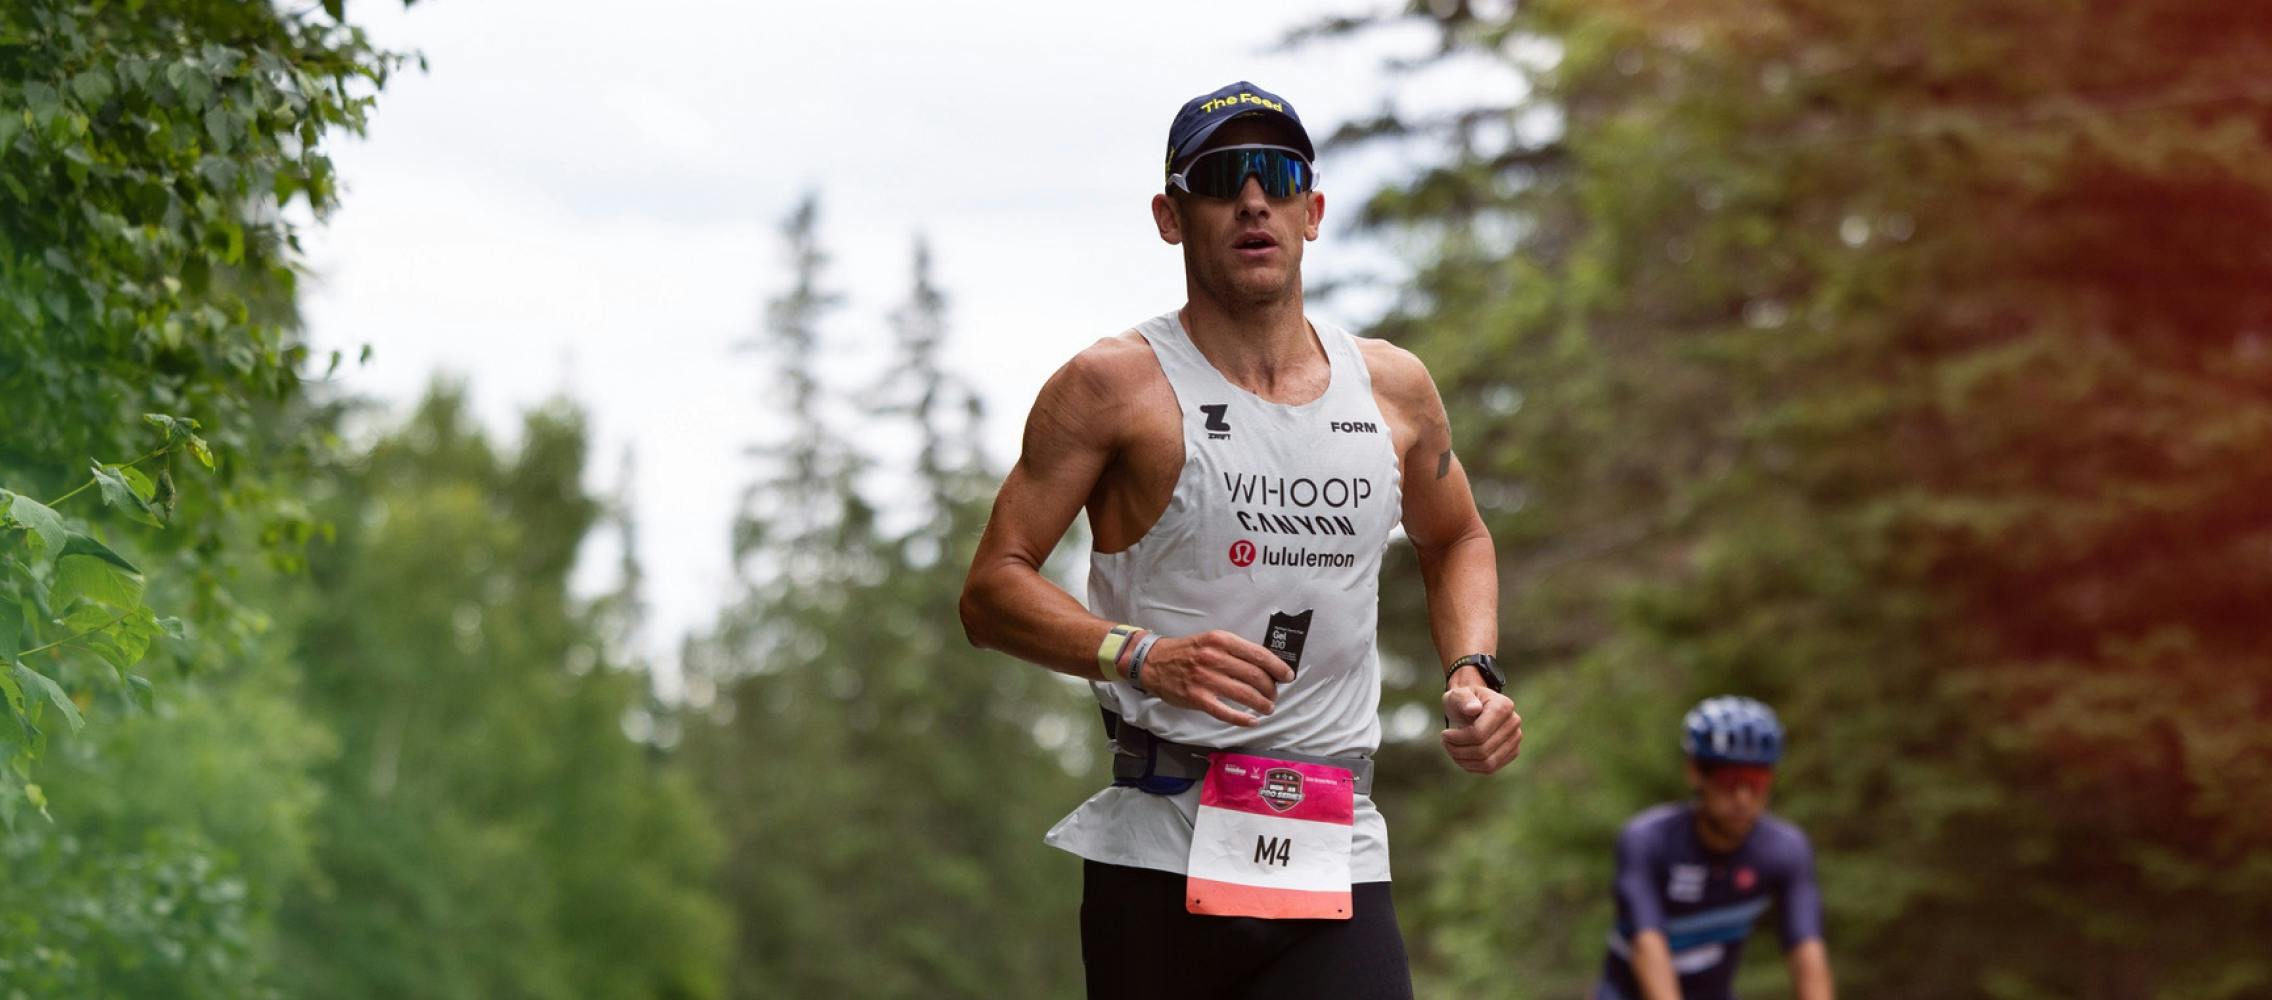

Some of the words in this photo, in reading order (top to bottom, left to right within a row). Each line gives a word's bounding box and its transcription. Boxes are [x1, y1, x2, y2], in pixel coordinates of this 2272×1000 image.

[1200, 96, 1238, 113] The
[1239, 93, 1283, 113] Feed
[1331, 421, 1378, 433] FORM
[1224, 472, 1371, 508] WHOOP
[1236, 511, 1356, 536] CANYON
[1262, 546, 1355, 567] lululemon
[1271, 639, 1287, 650] 100
[1273, 630, 1287, 641] Gel
[1254, 835, 1291, 867] M4
